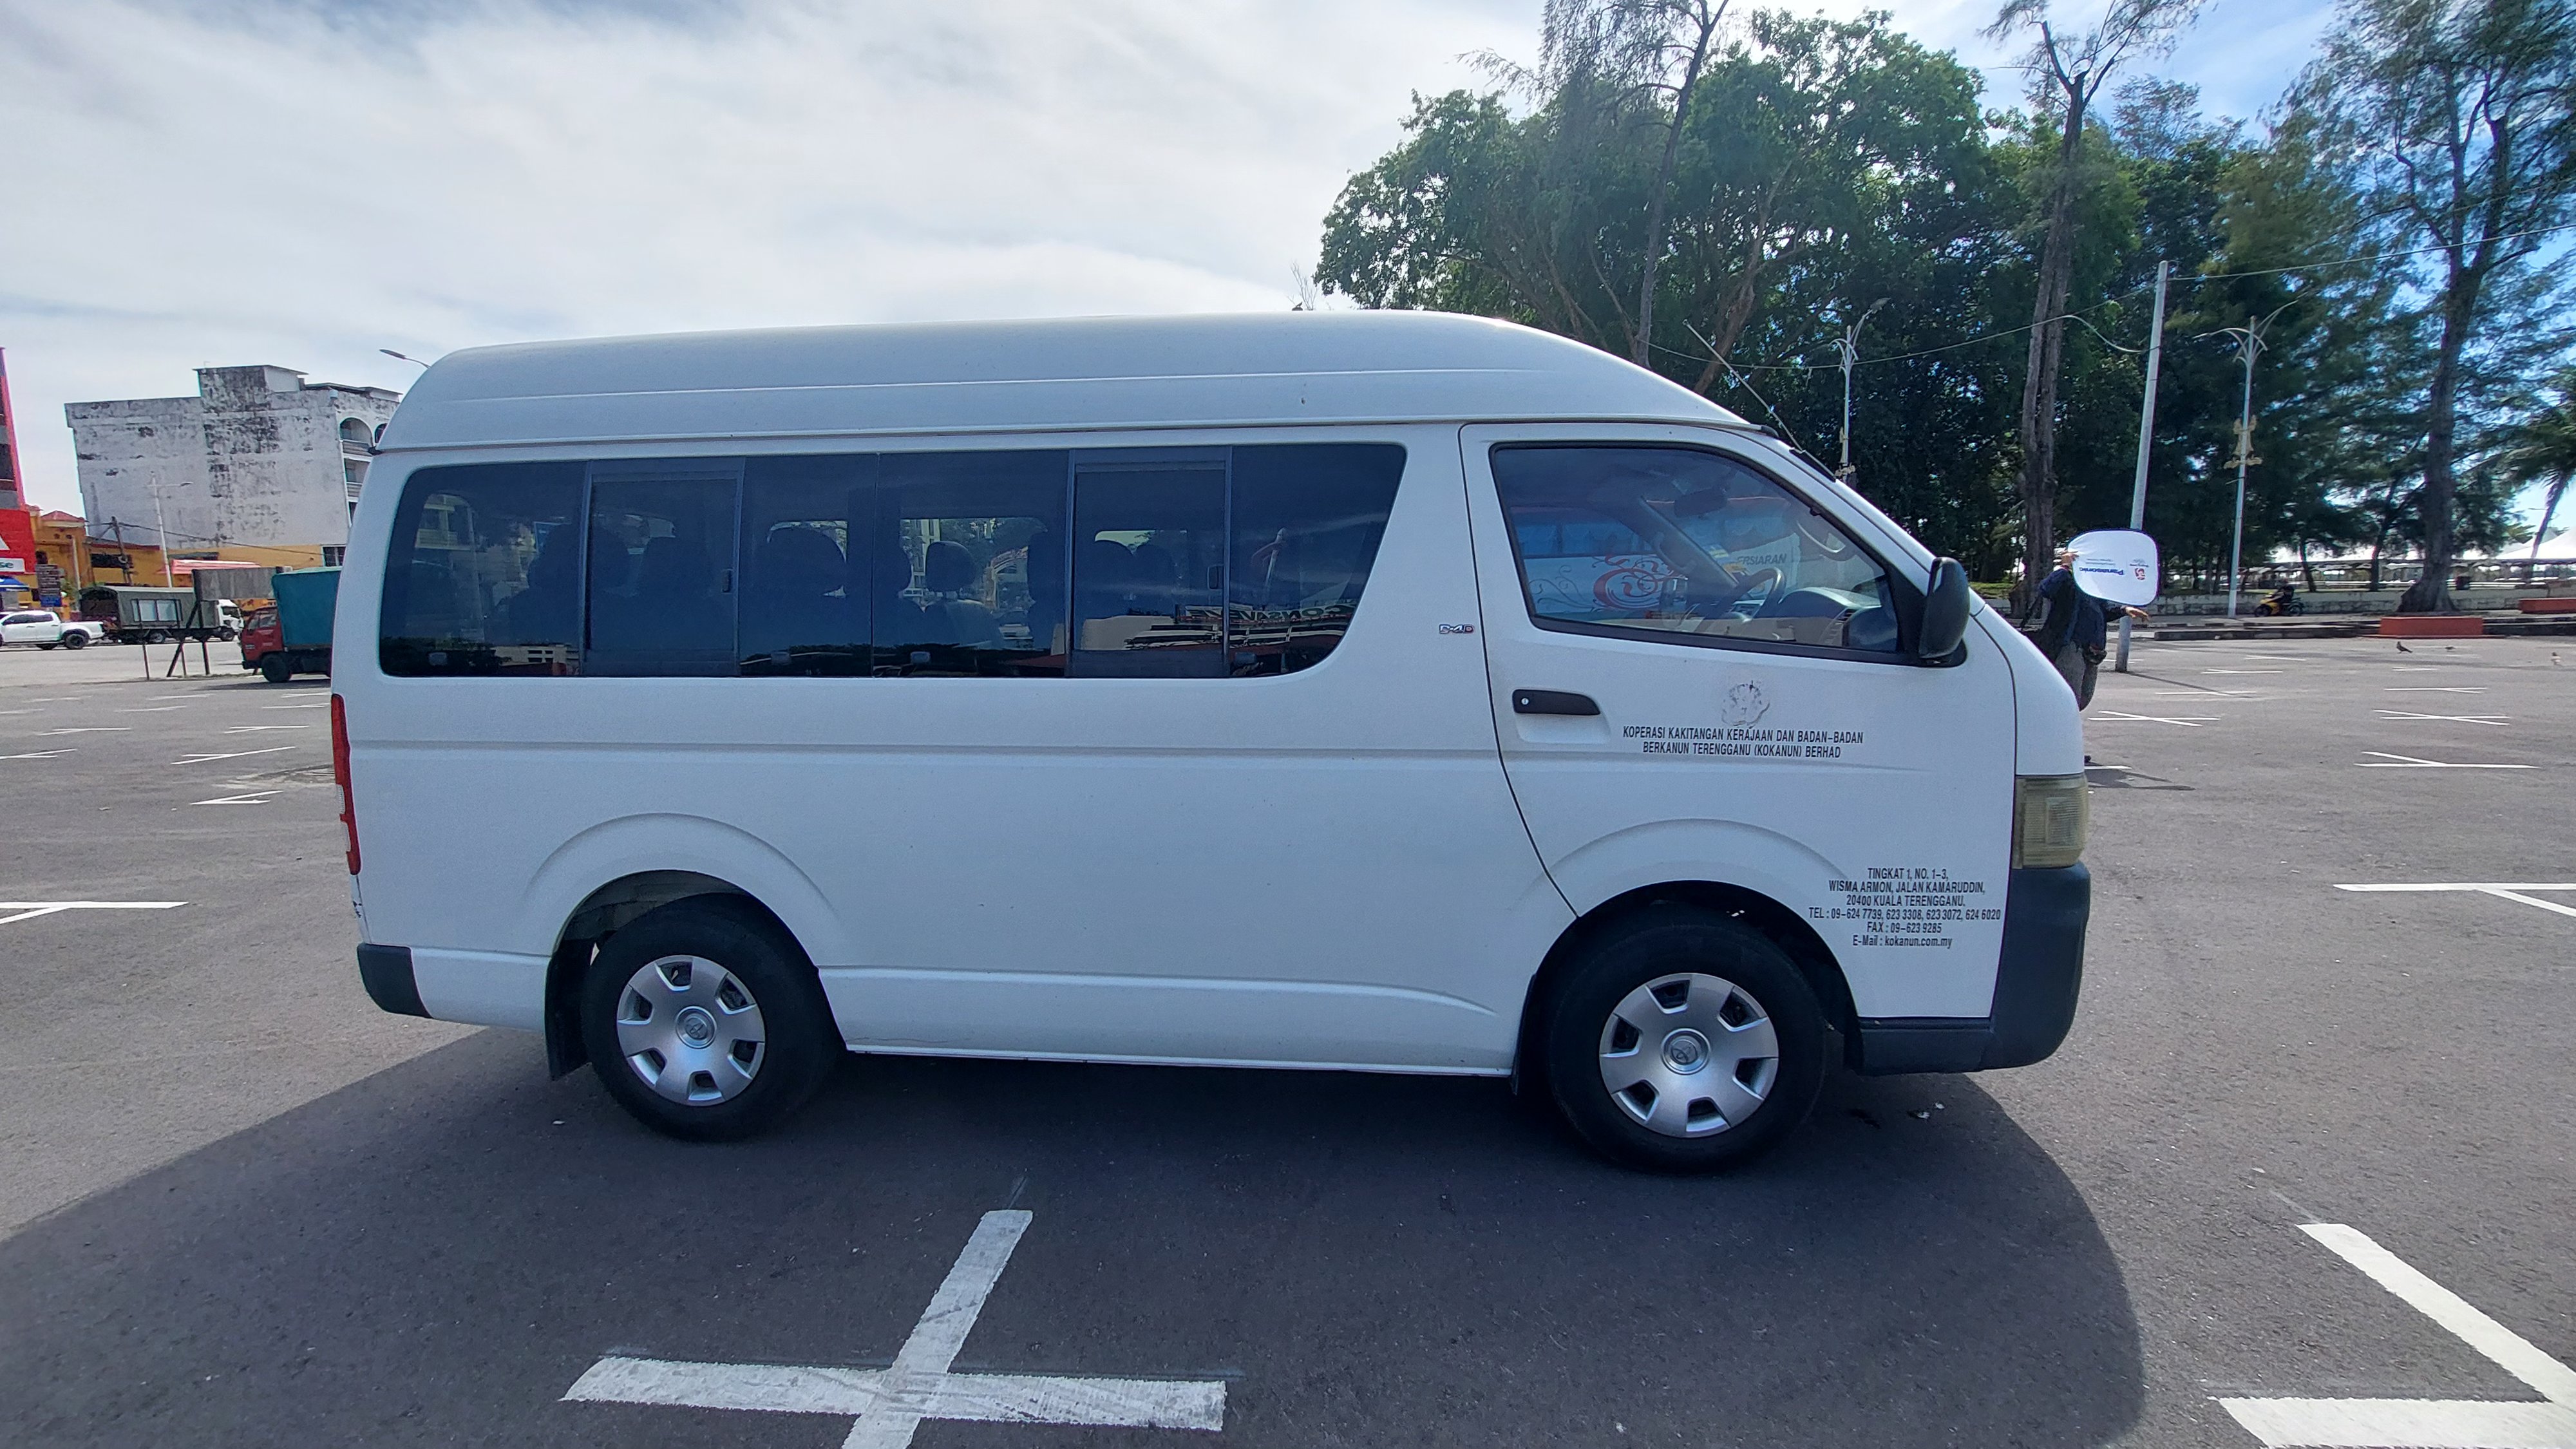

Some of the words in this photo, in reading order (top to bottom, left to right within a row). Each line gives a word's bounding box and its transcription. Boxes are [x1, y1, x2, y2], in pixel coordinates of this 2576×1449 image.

[1738, 554, 1787, 565] ERSIARAN
[1439, 624, 1474, 634] D-4D
[1623, 726, 1665, 739] KOPERASI
[1668, 727, 1724, 740] KAKITANGAN
[1727, 728, 1773, 741] KERAJAAN
[1776, 730, 1794, 741] DAN
[1797, 730, 1864, 743] BADAN-BADAN
[1643, 741, 1689, 754] BERKANUN
[1692, 743, 1751, 755] TERENGGANU
[1754, 744, 1802, 757] (KOKANUN)
[1805, 746, 1841, 758] BERHAD
[1868, 867, 1904, 879] TINGKAT
[1906, 868, 1912, 881] 1,
[1915, 867, 1929, 880] NO.
[1931, 868, 1949, 881] 1-3,
[1829, 880, 1858, 892] WISMA
[1860, 881, 1893, 894] ARMON,
[1895, 882, 1924, 893] JALAN
[1926, 882, 1985, 895] KAMARUDDIN,
[1846, 894, 1871, 906] 20400
[1873, 895, 1902, 906] KUALA
[1831, 907, 1860, 919] 09-624
[1862, 908, 1884, 920] 7739,
[1886, 909, 1900, 920] 623
[1902, 909, 1924, 921] 3308,
[1926, 909, 1940, 920] 623
[1942, 909, 1963, 922] 3072,
[1965, 909, 1979, 920] 624
[1981, 909, 2001, 920] 6020
[1890, 922, 1920, 933] 09-623
[1922, 922, 1942, 933] 9285
[1884, 935, 1953, 949] kokanun.com.my
